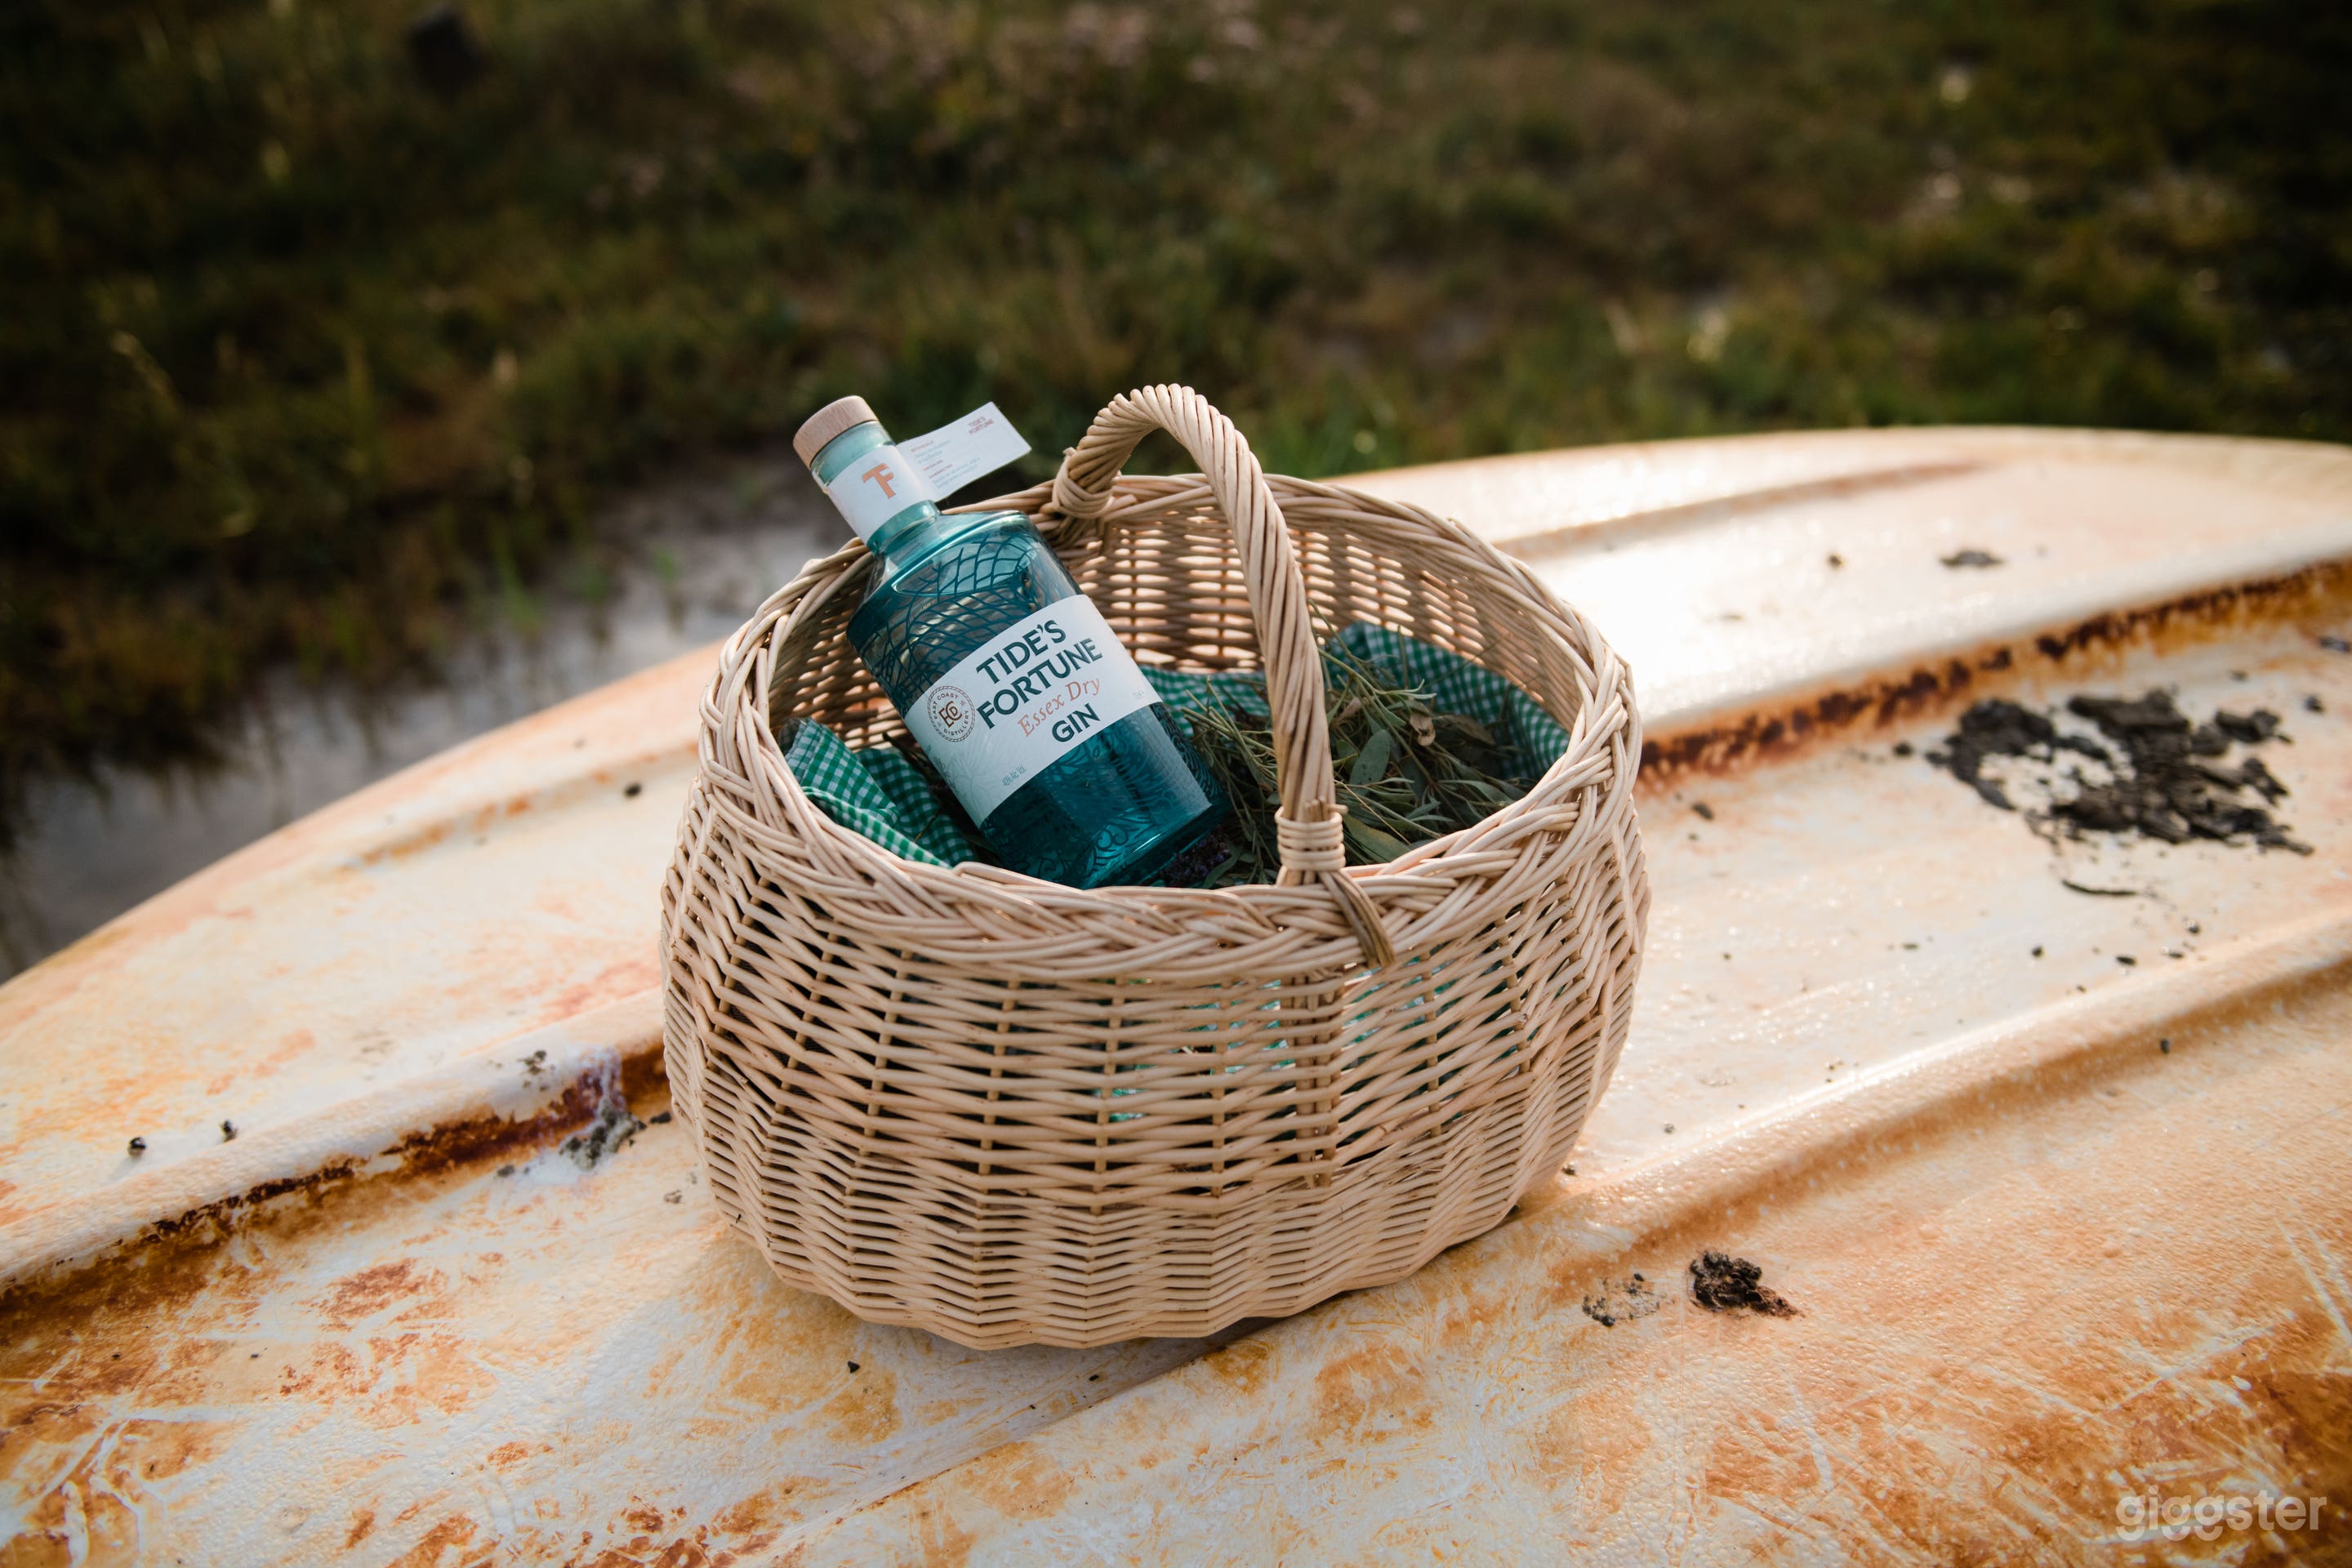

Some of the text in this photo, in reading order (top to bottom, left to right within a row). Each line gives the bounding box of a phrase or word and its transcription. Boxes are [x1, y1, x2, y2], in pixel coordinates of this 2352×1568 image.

[976, 620, 1067, 684] TIDE'S
[937, 693, 959, 701] COAST
[976, 638, 1103, 729] FORTUNE
[1018, 678, 1100, 737] Essex Dry
[943, 710, 969, 736] DISTILLERY
[1052, 702, 1100, 742] GIN
